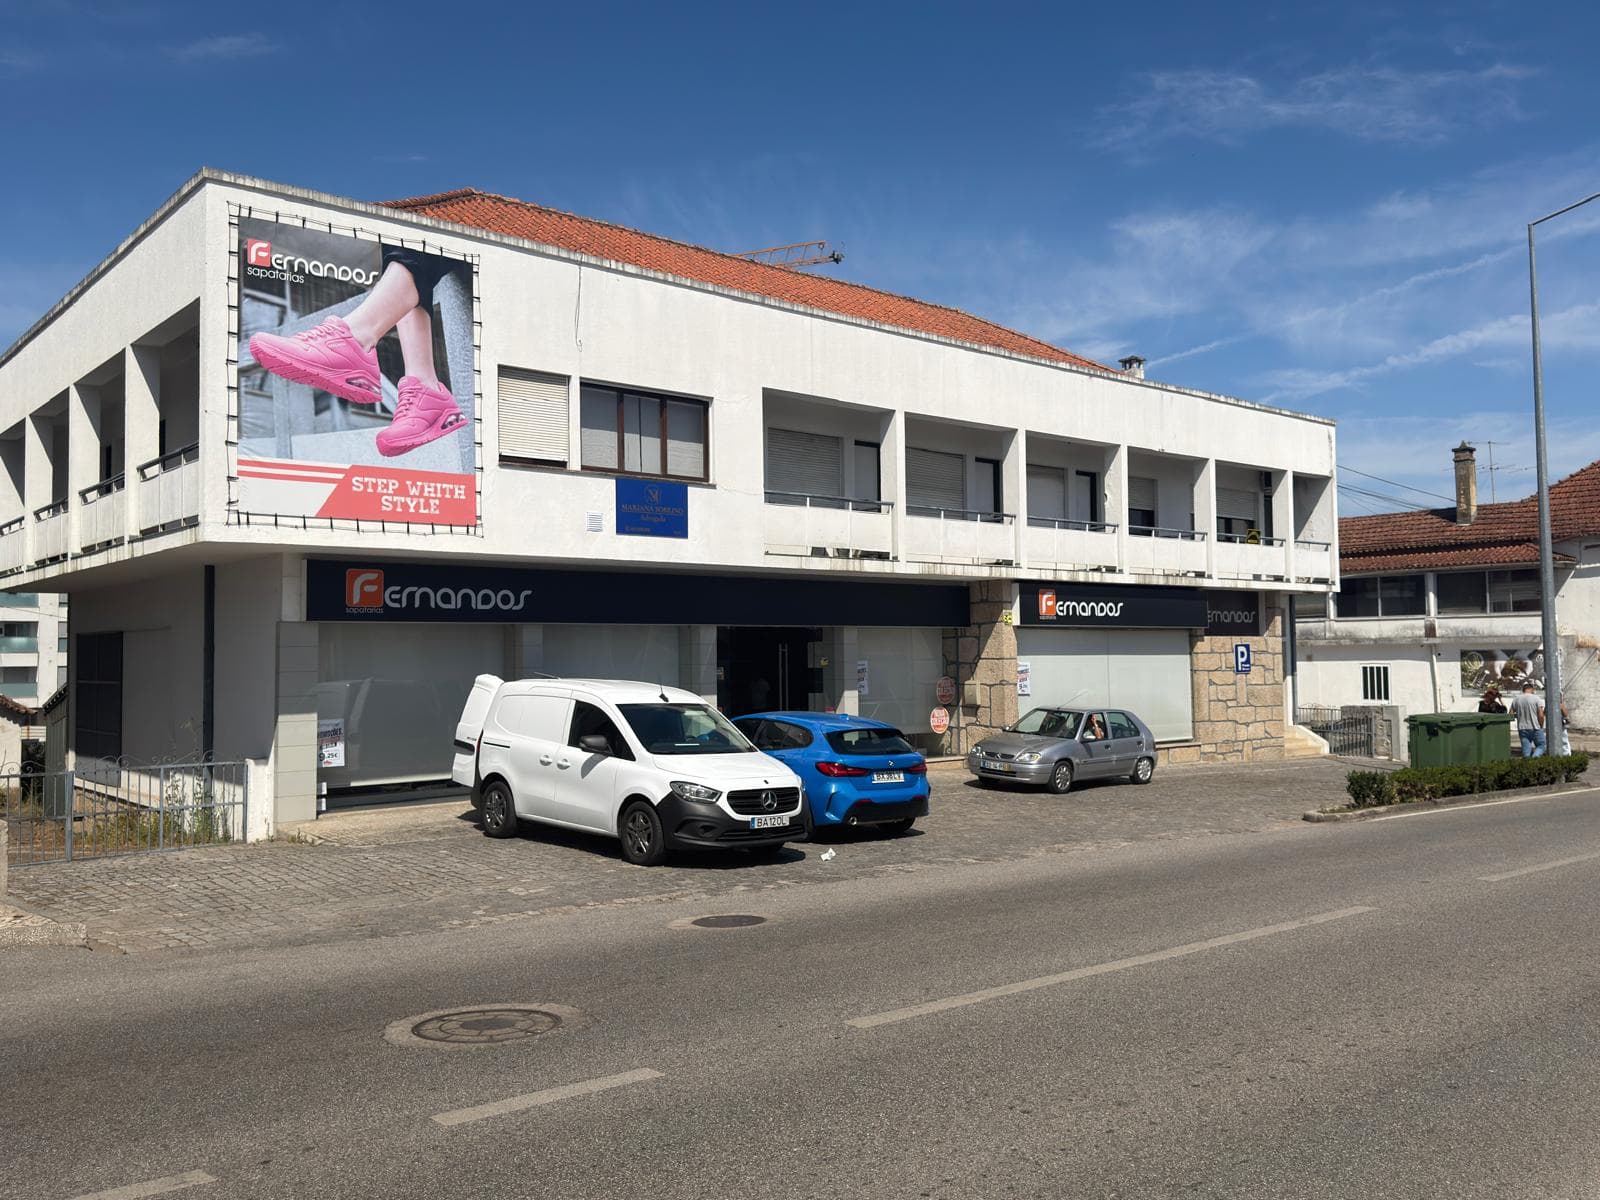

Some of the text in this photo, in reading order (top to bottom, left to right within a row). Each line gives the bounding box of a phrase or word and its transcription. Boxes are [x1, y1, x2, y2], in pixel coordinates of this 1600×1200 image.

[246, 266, 305, 284] sapatarias
[351, 476, 466, 499] STEP WHITH
[381, 495, 440, 514] STYLE
[1207, 610, 1256, 623] ernandos
[1237, 645, 1248, 671] P
